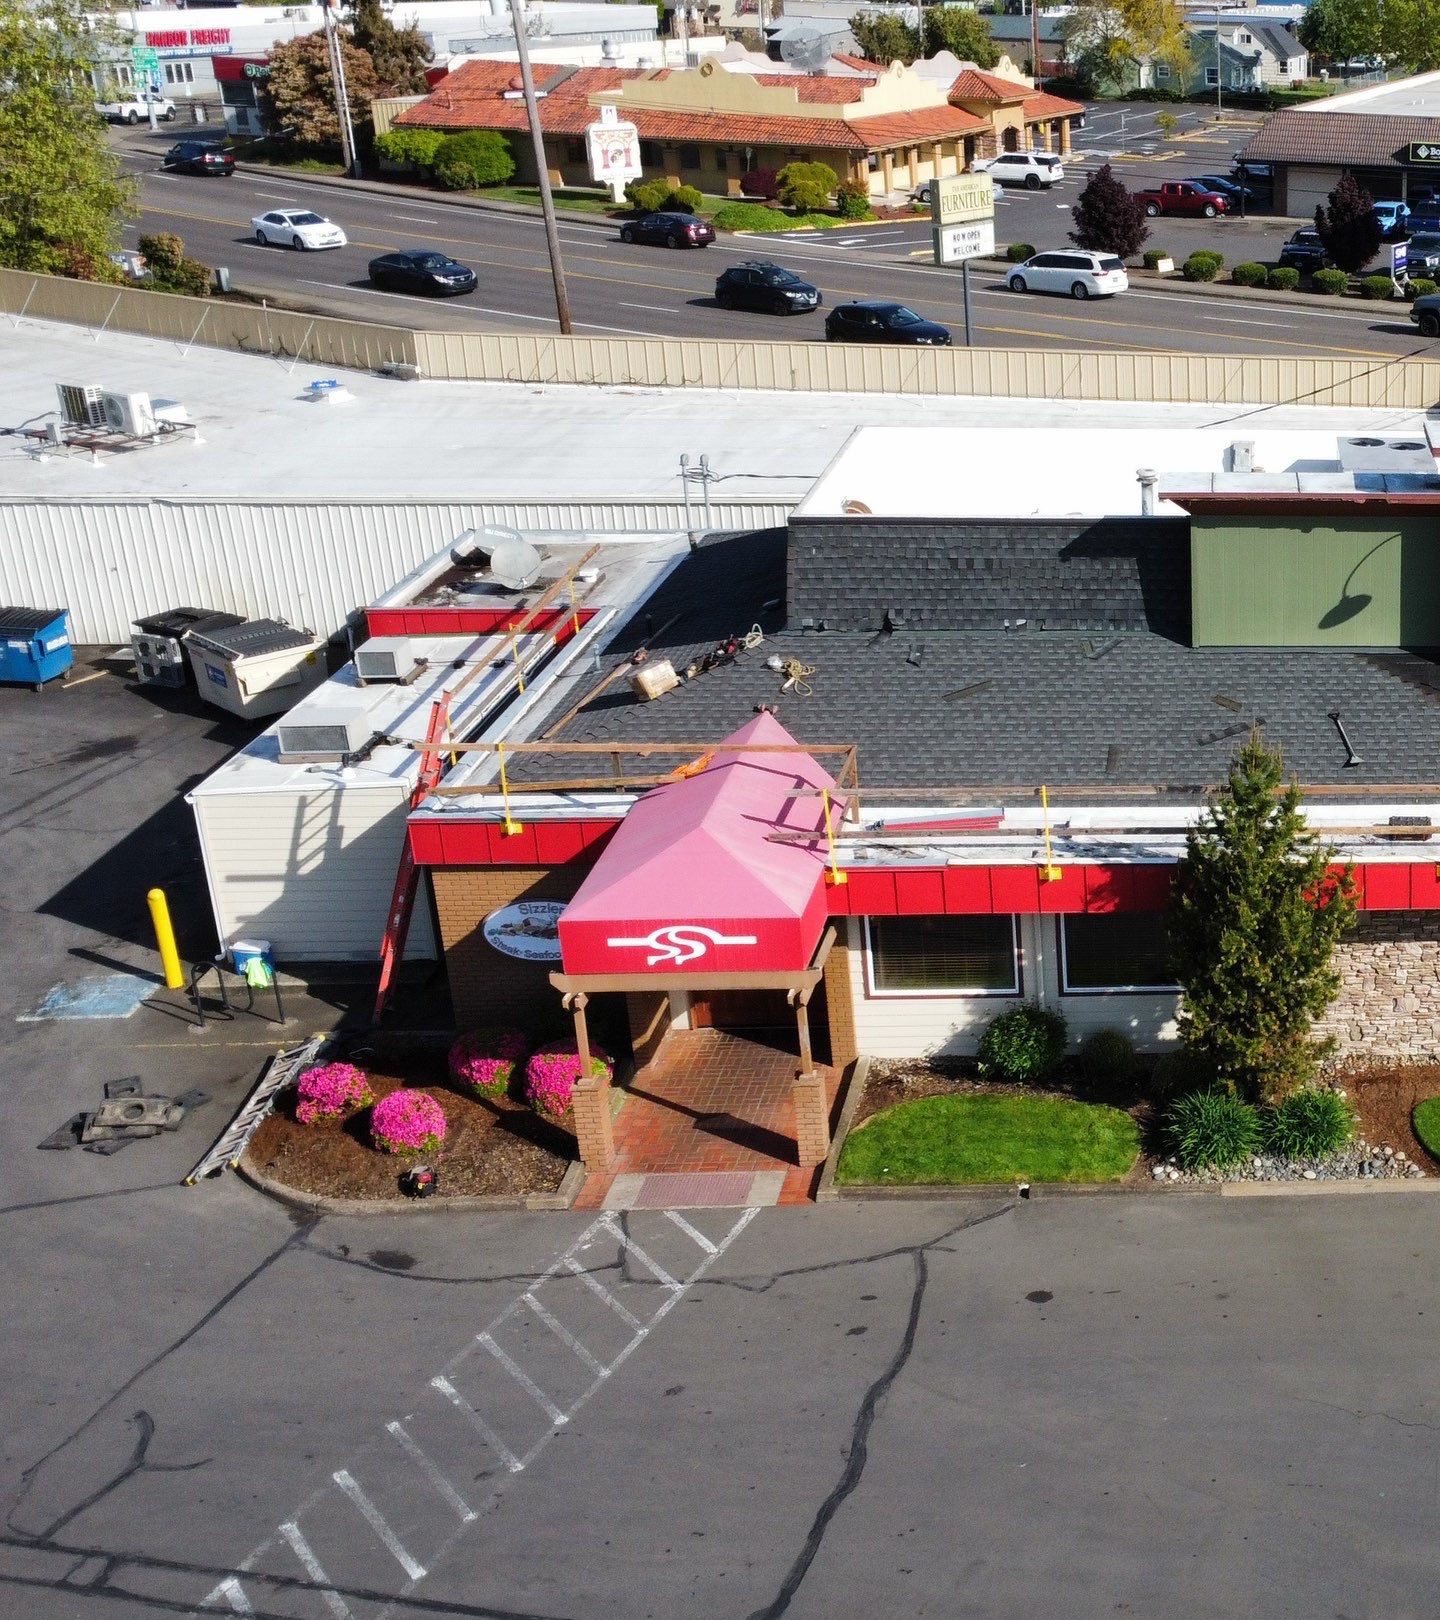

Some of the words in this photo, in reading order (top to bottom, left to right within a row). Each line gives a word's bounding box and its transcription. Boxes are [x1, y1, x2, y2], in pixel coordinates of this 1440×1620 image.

[146, 31, 188, 47] HARBOR
[190, 28, 231, 45] FREIGHT
[942, 189, 992, 213] FURNITURE
[953, 232, 967, 242] NOW
[967, 230, 981, 240] OPEN
[953, 242, 981, 256] WELCOME
[524, 949, 562, 959] Seafoo
